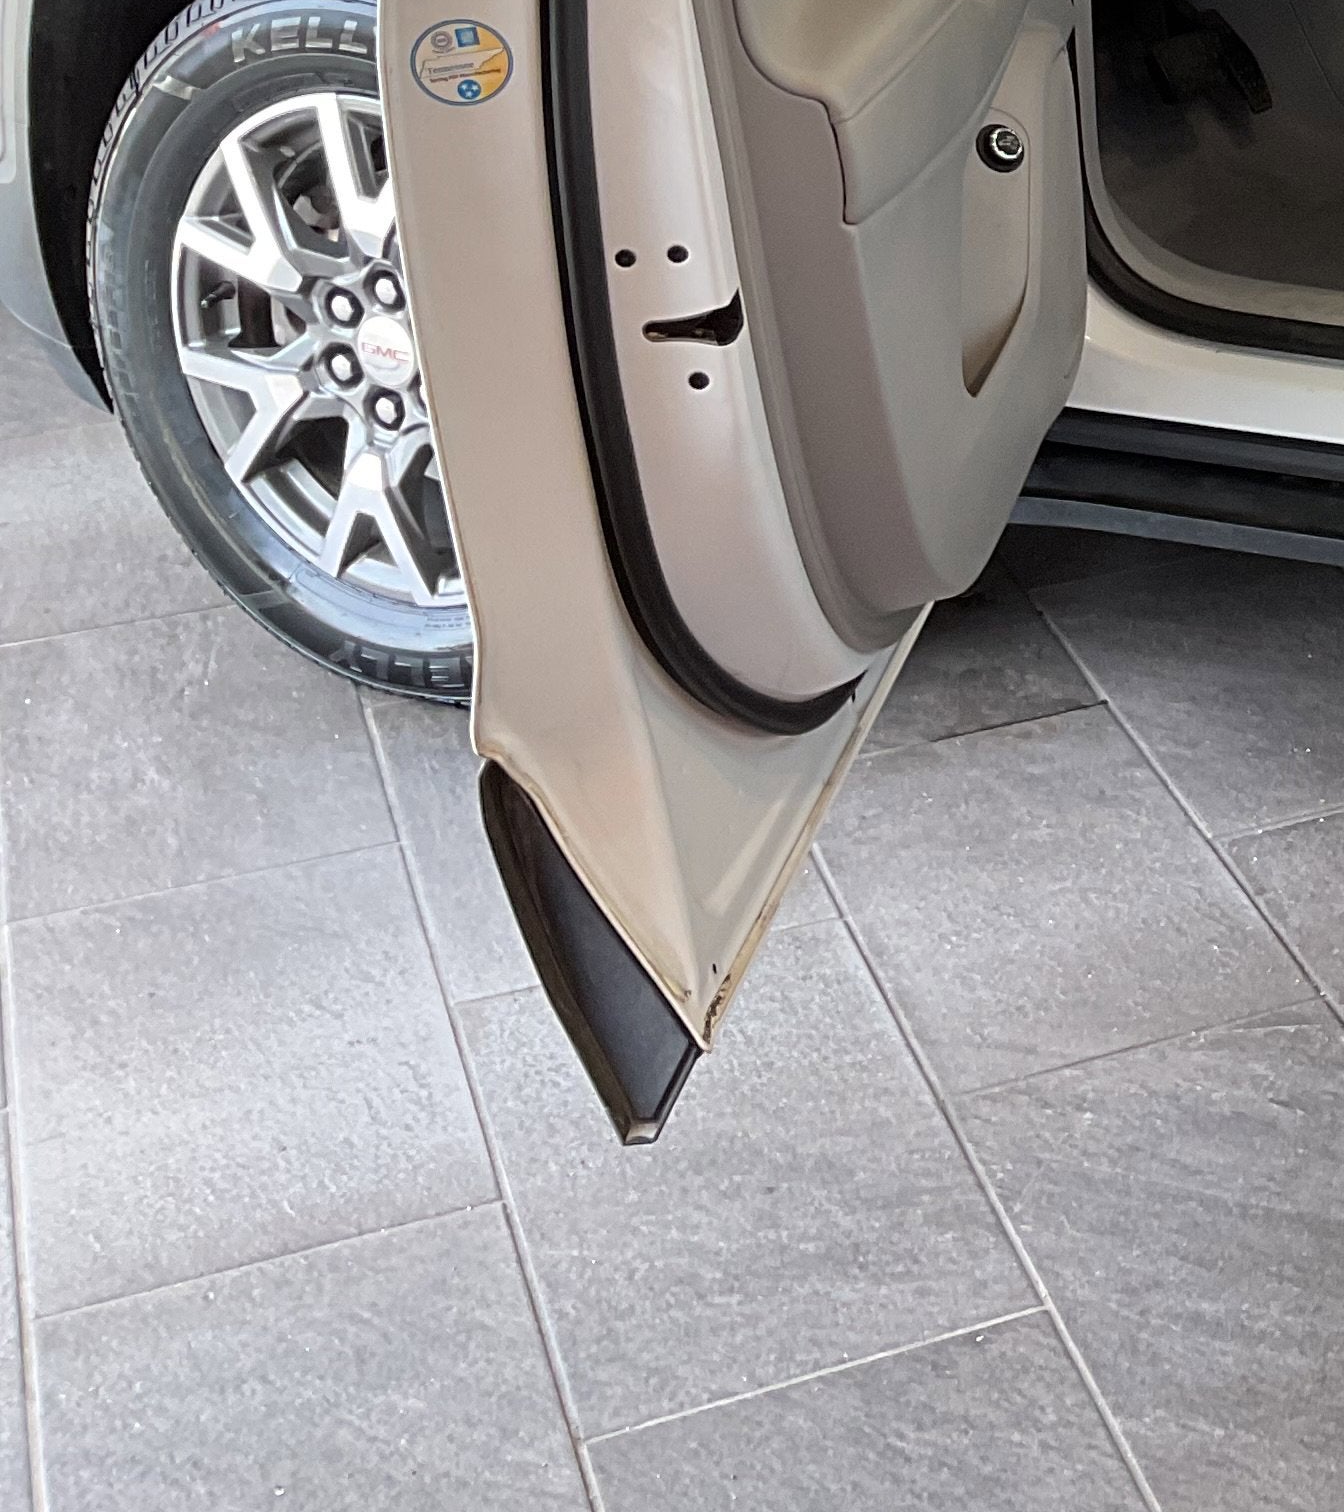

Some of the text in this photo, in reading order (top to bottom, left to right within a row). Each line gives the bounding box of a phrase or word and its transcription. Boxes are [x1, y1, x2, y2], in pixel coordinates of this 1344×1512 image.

[231, 16, 378, 63] KELL
[360, 341, 409, 366] GMC
[328, 639, 473, 688] ELLY
